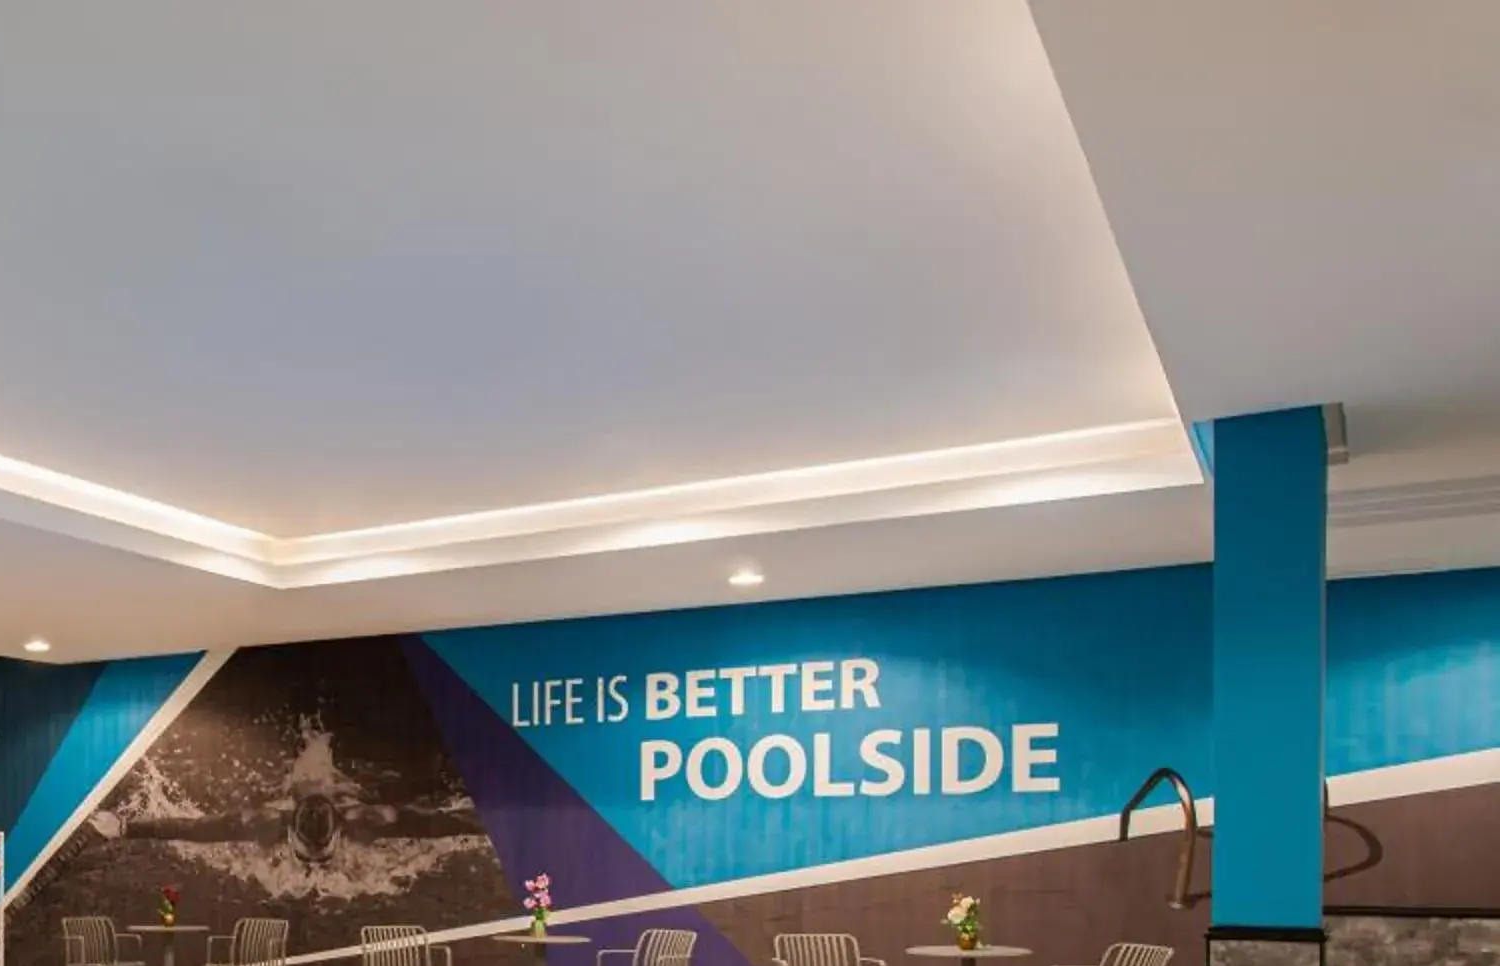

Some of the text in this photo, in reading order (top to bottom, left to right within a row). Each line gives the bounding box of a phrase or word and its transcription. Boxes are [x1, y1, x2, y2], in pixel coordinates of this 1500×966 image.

[511, 657, 882, 728] LIFE IS BETTER
[639, 723, 1061, 802] POOLSIDE
